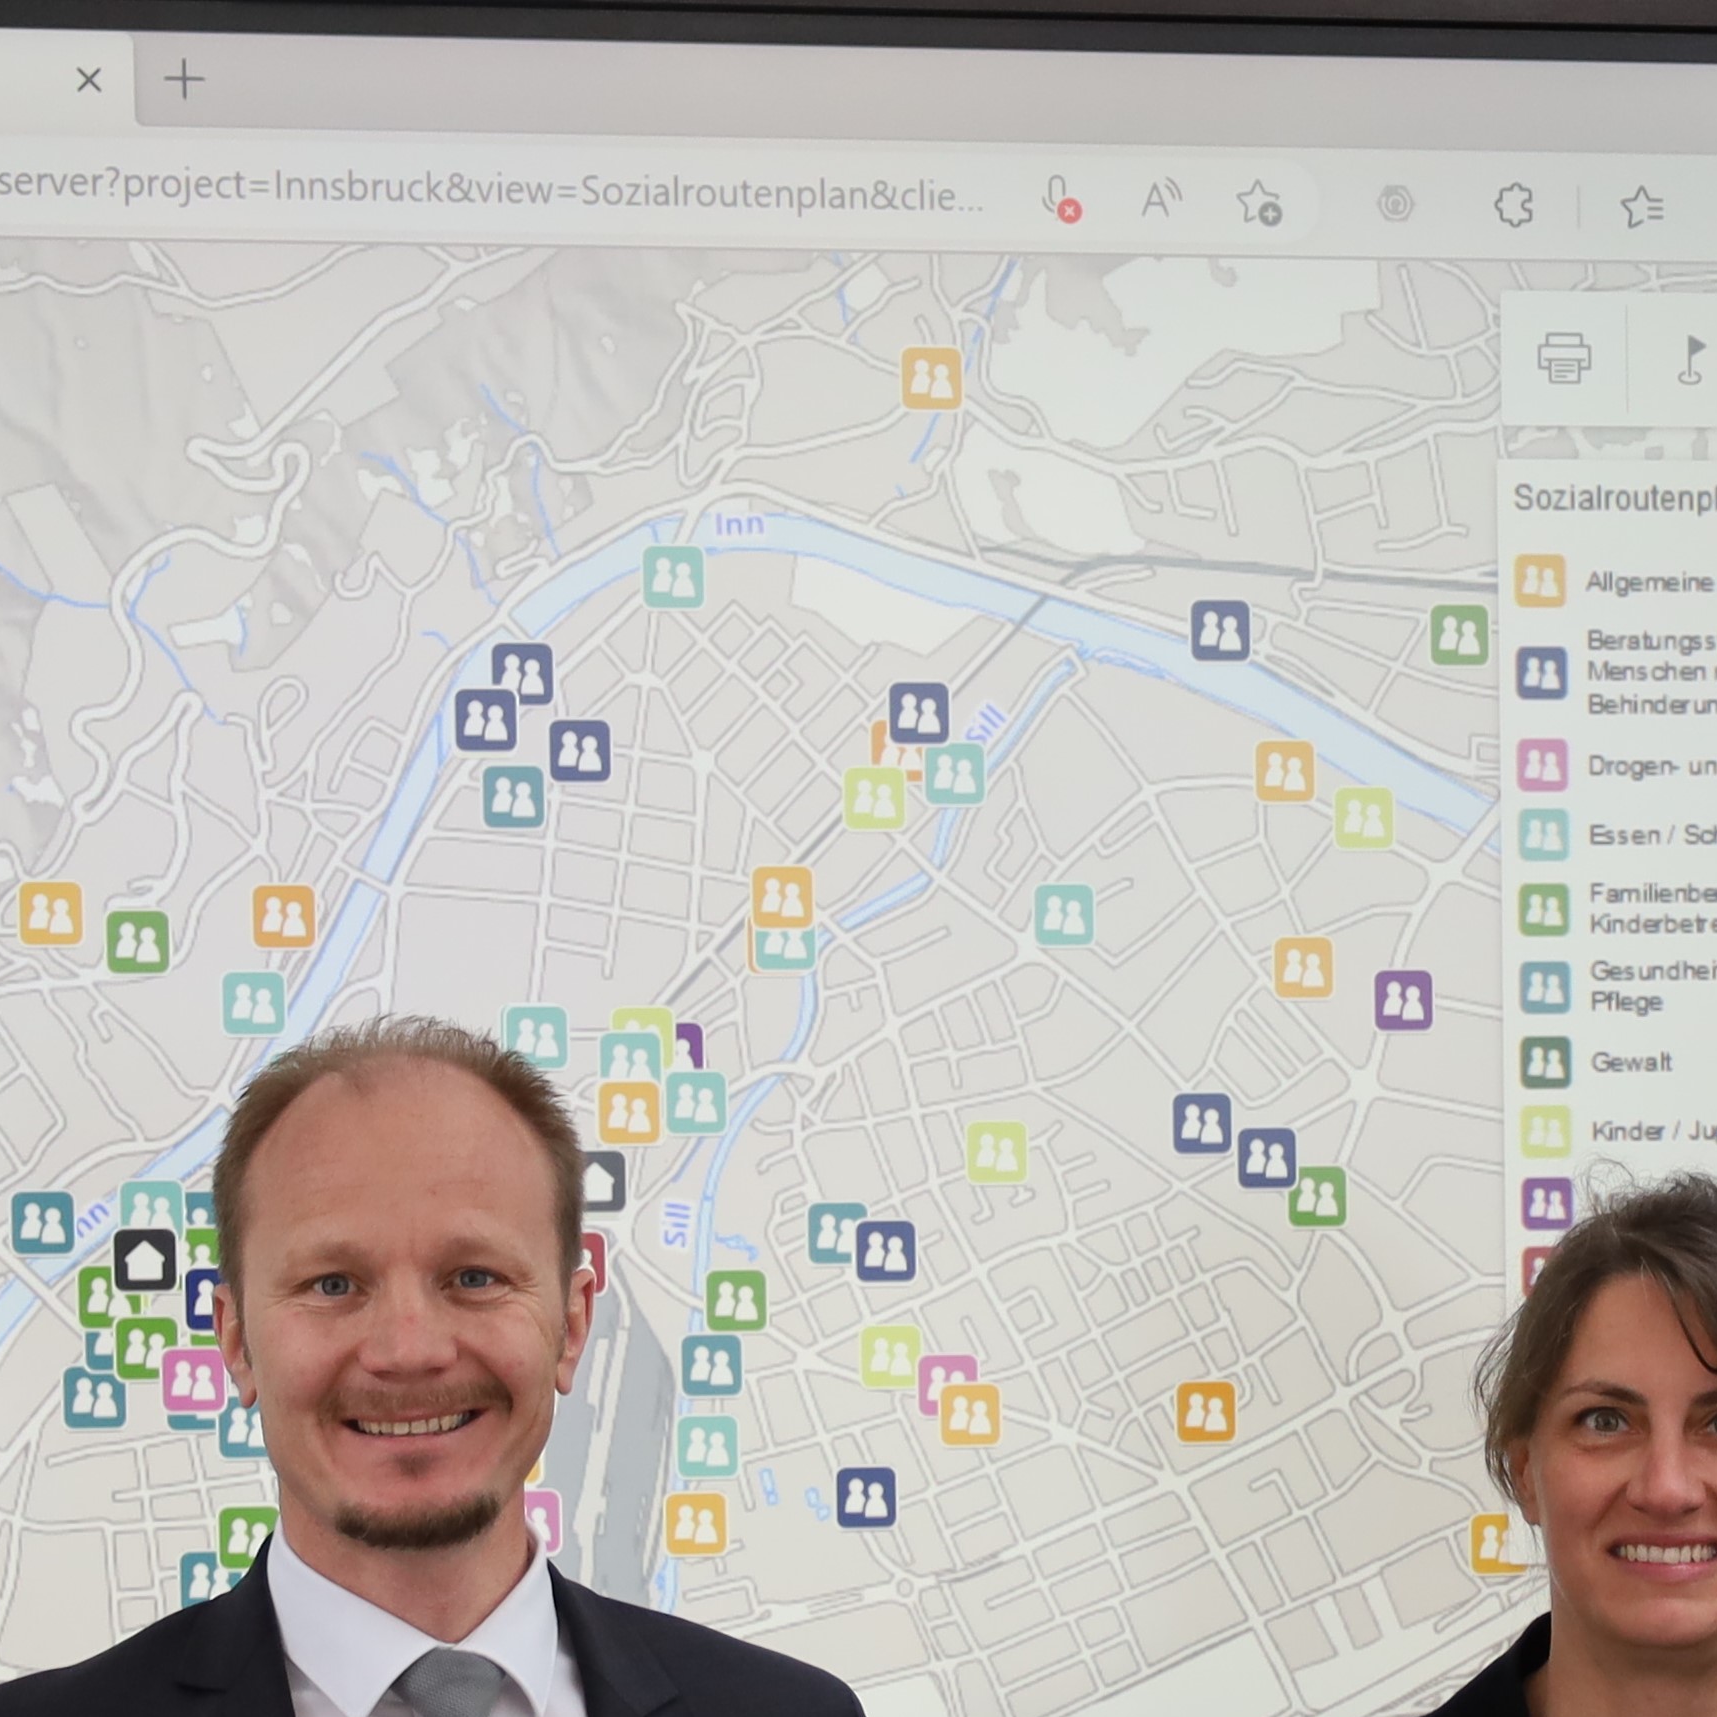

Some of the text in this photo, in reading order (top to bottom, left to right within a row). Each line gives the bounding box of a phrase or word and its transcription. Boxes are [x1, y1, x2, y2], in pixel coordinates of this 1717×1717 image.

[715, 512, 764, 536] Inn
[1586, 571, 1715, 598] Allgemeine
[1588, 661, 1707, 683] Menschen
[1588, 756, 1682, 781] Drogen-
[1589, 825, 1661, 846] Essen
[1591, 990, 1664, 1014] Pflege
[1591, 1051, 1674, 1074] Gewalt
[1592, 1119, 1666, 1142] Kinder
[76, 1202, 111, 1239] nn
[664, 1202, 691, 1249] Sill
